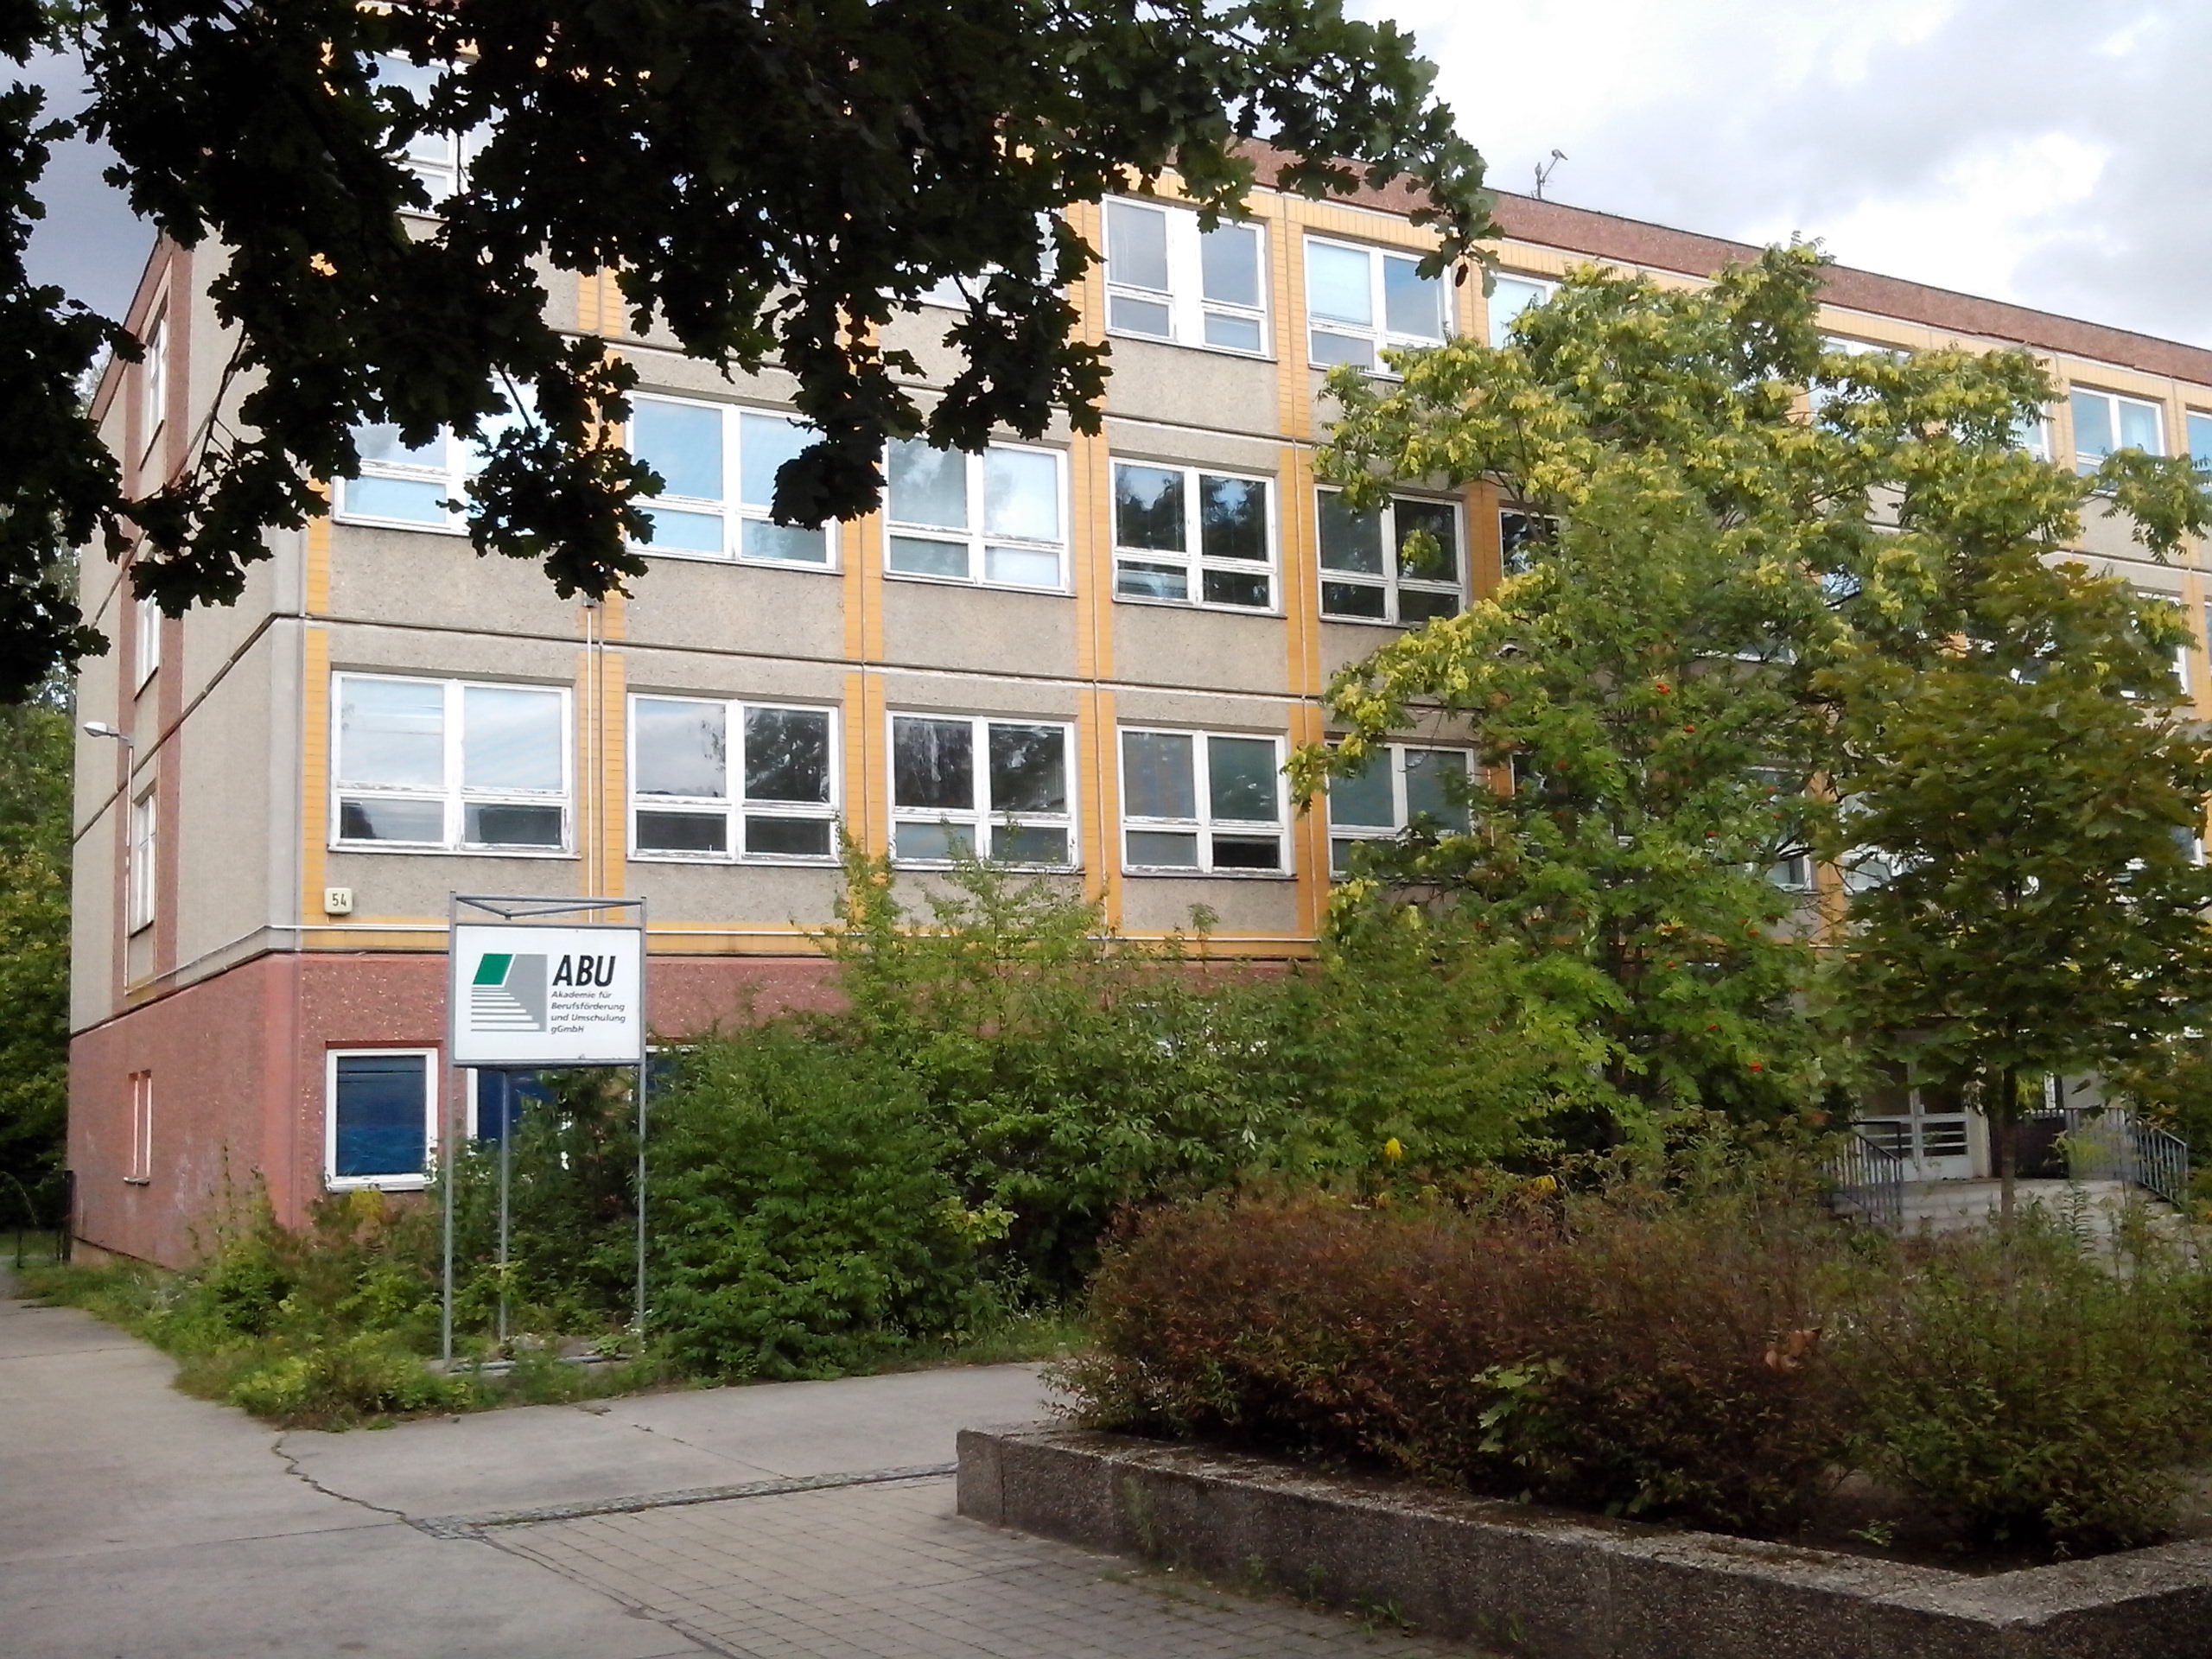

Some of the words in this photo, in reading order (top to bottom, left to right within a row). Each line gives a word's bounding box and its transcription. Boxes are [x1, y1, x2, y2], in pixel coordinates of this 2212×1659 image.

[332, 893, 346, 906] 54
[552, 954, 616, 987] ABU
[550, 990, 596, 999] Akademie
[598, 990, 612, 999] für
[550, 1002, 626, 1012] Berufsförderung
[571, 1014, 626, 1024] Umschulung
[550, 1026, 584, 1035] gGmbH
